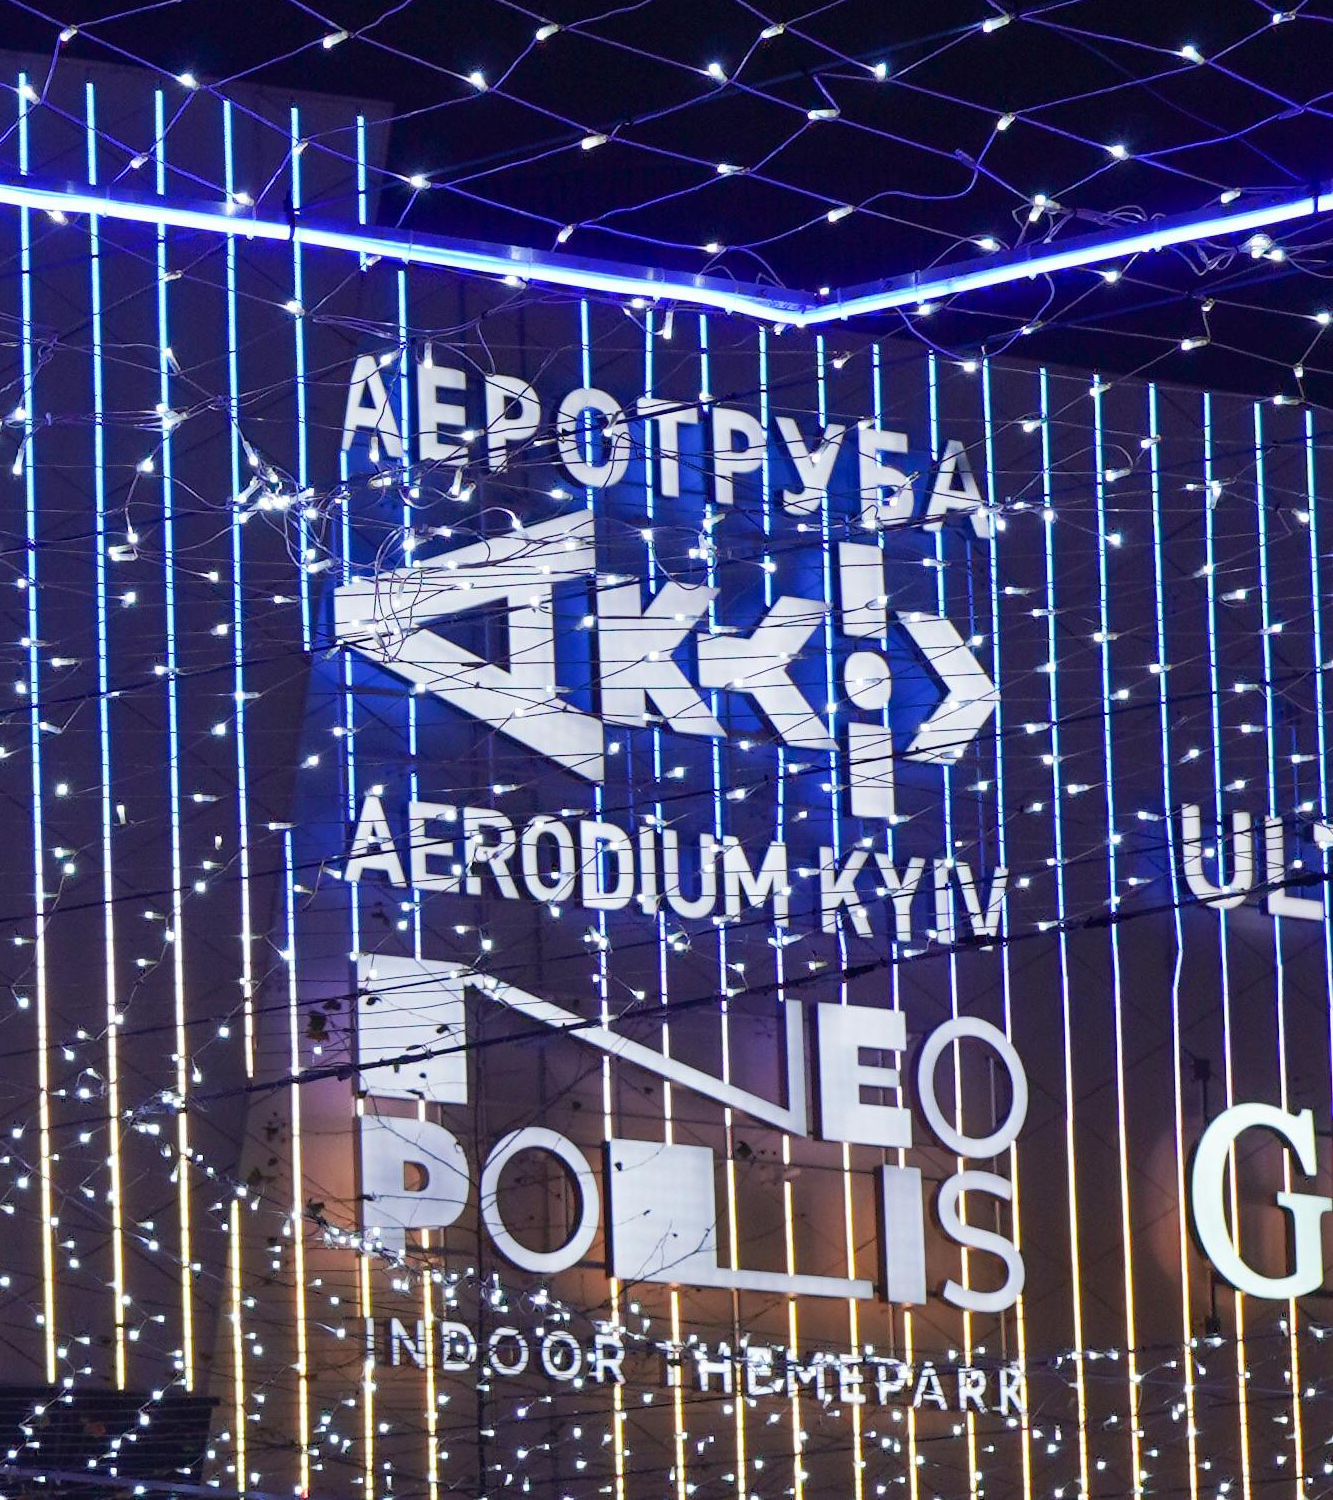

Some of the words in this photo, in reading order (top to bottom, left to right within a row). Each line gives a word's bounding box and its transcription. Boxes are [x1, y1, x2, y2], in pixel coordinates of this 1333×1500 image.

[341, 354, 991, 538] АЕРОТРУБА
[345, 794, 790, 928] AERODIUM
[821, 844, 1010, 950] KYIV
[1182, 802, 1333, 922] UL
[366, 1318, 626, 1384] INDOOR
